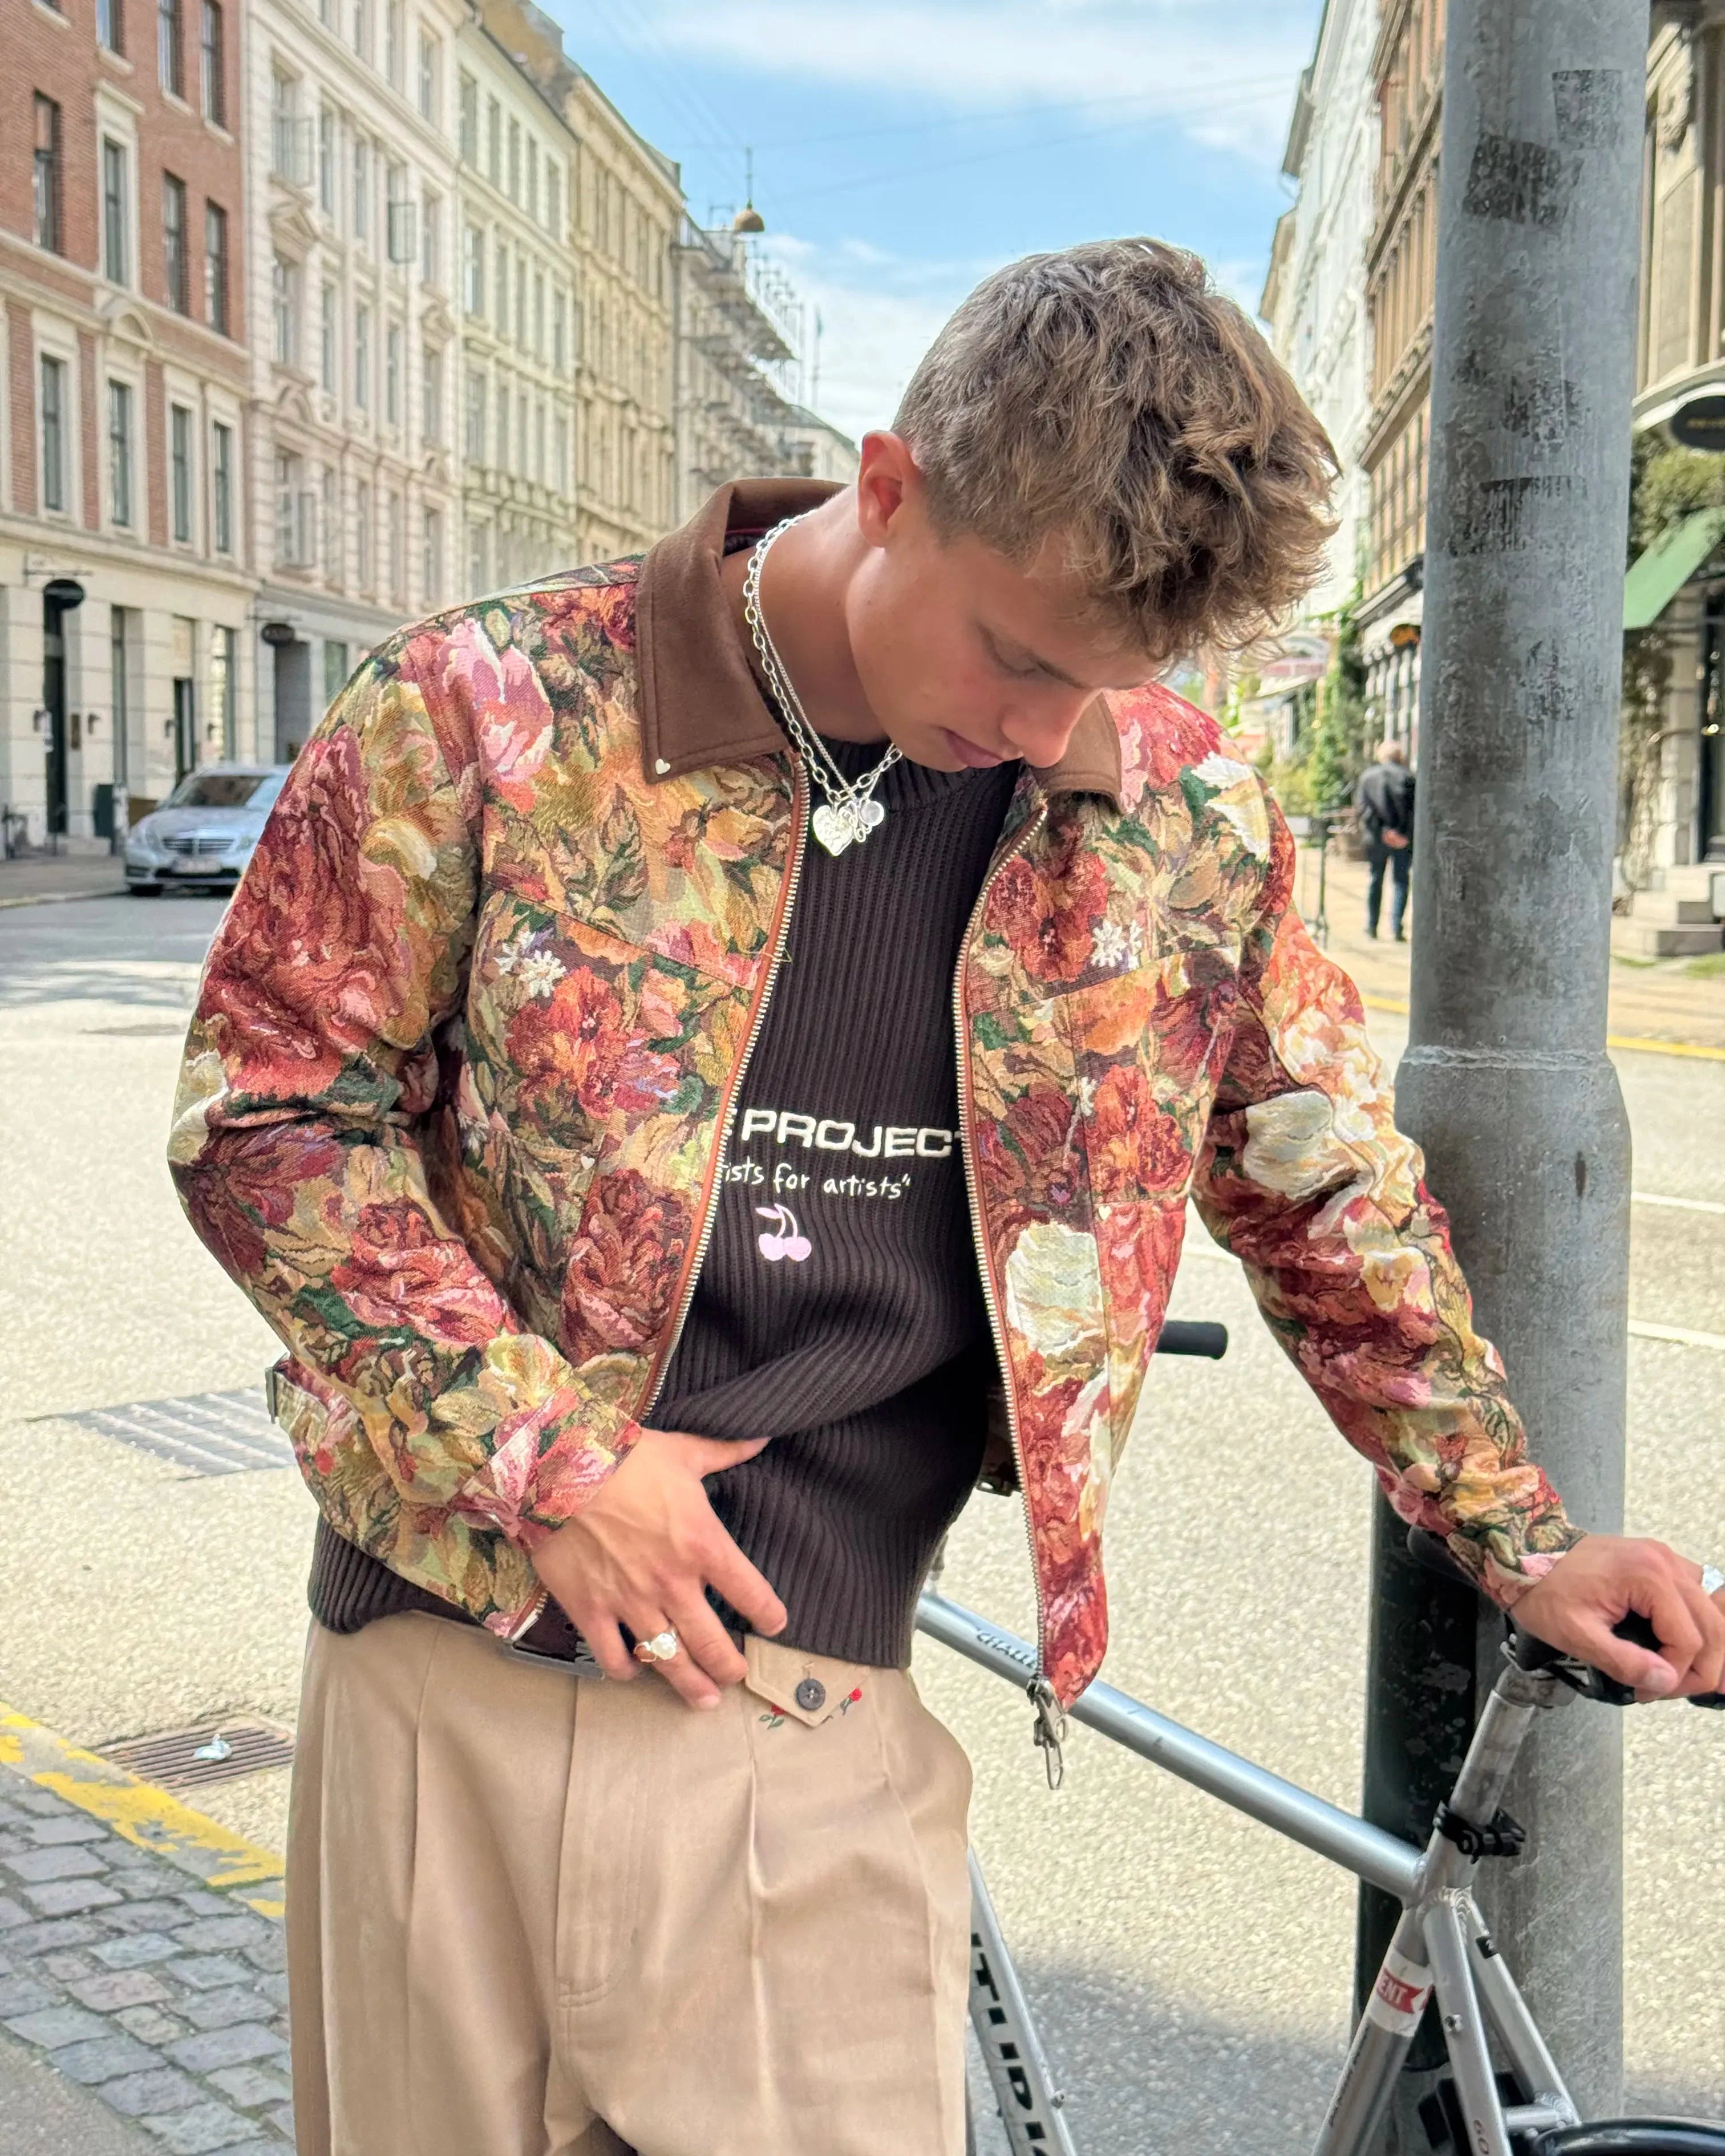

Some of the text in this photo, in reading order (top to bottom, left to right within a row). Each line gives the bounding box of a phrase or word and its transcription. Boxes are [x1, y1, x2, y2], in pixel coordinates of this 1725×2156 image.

[742, 1108, 961, 1158] PROJEC
[723, 1155, 764, 1185] ists
[773, 1162, 810, 1194] for
